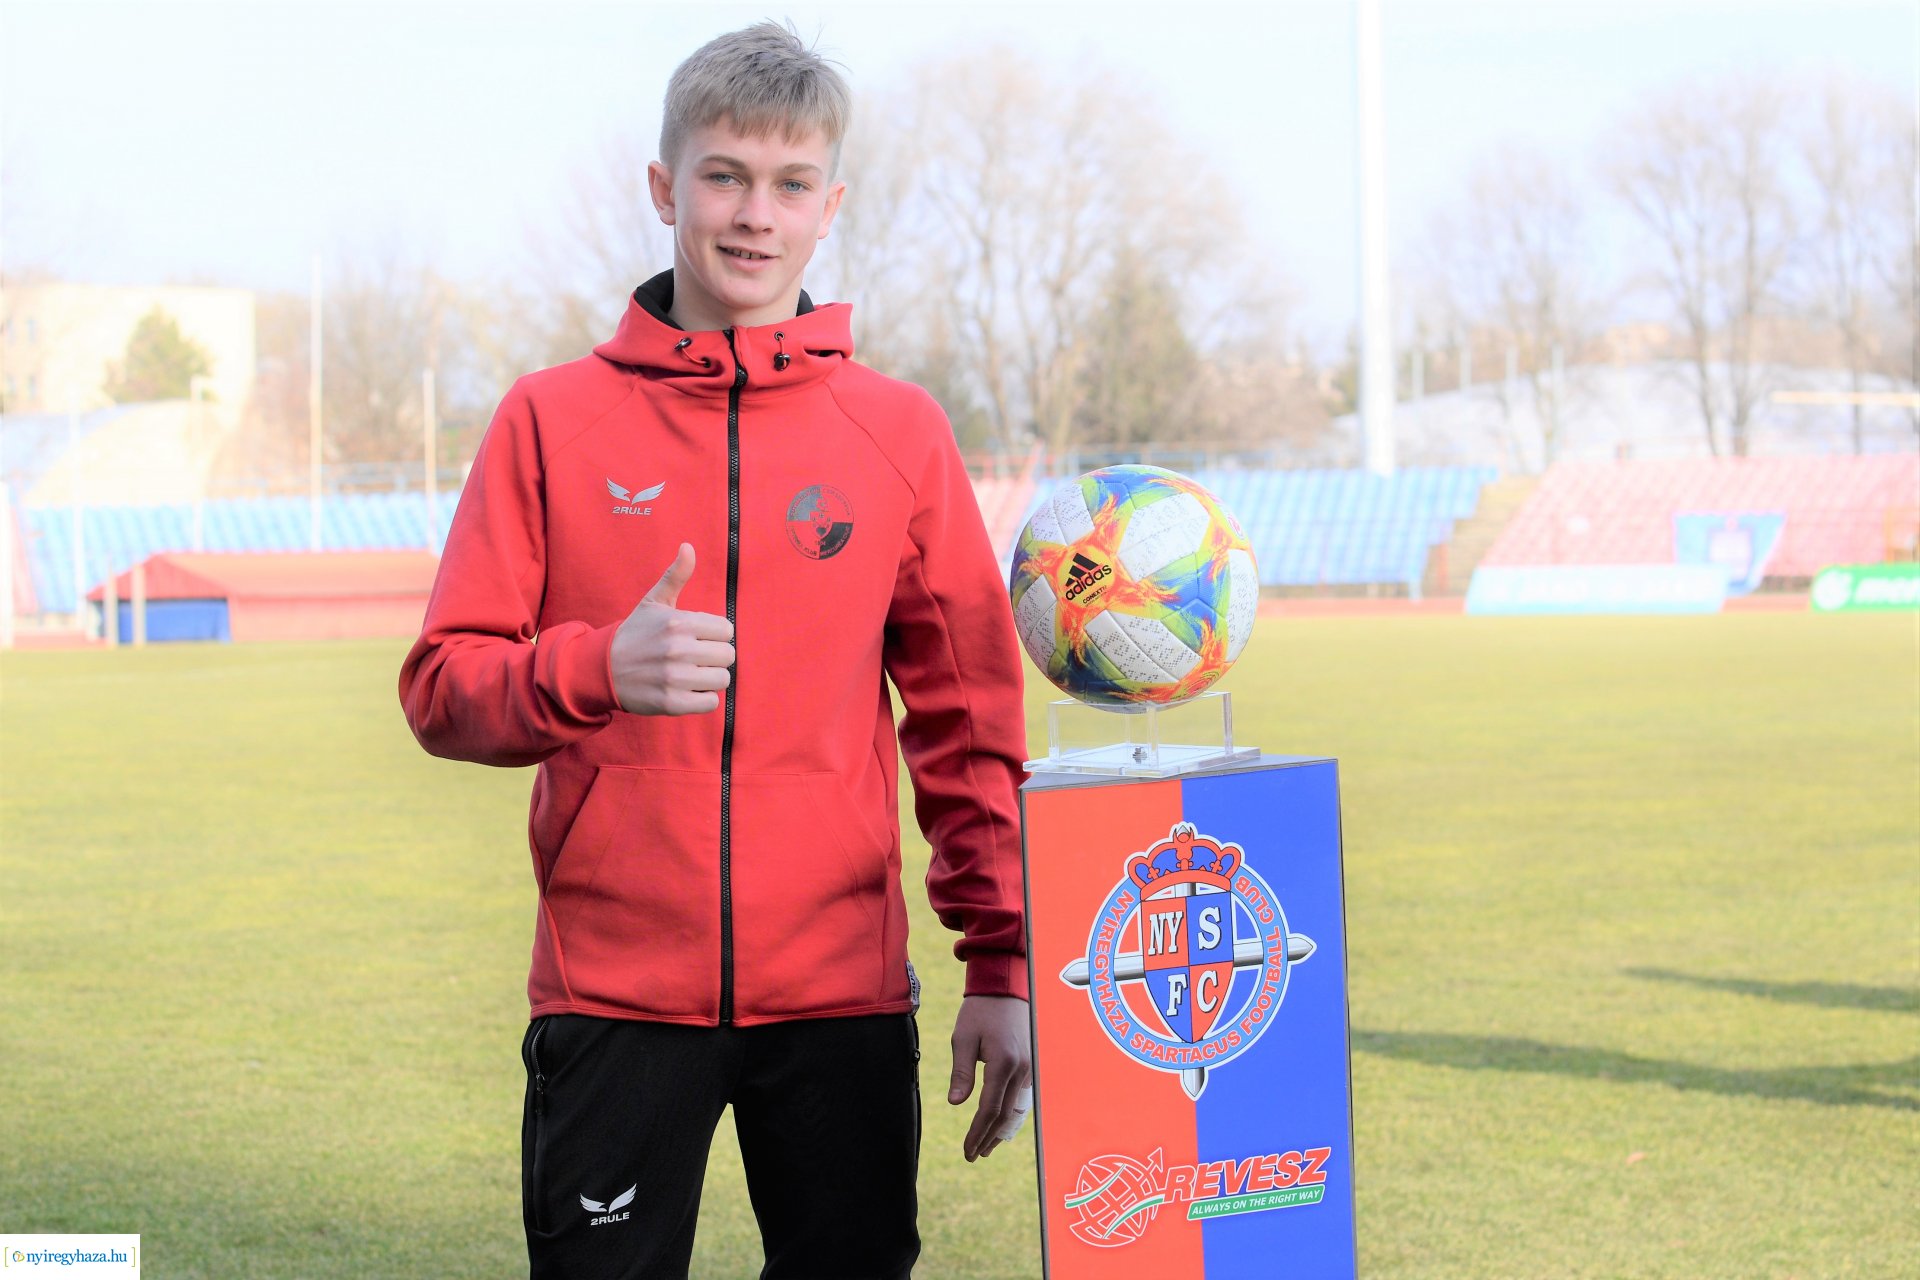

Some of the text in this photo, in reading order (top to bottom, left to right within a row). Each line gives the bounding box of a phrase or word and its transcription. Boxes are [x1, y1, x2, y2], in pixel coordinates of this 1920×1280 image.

[612, 506, 652, 516] 2RULE
[1065, 565, 1112, 600] adidas
[1148, 906, 1222, 956] NY S
[1094, 875, 1283, 1064] NYÍREGYHÁZA SPARTACUS FOOTBALL CLUB
[1166, 970, 1219, 1018] F C
[590, 1212, 630, 1226] 2RULE
[1191, 1189, 1320, 1215] ALWAYS ON THE RIGHT WAY
